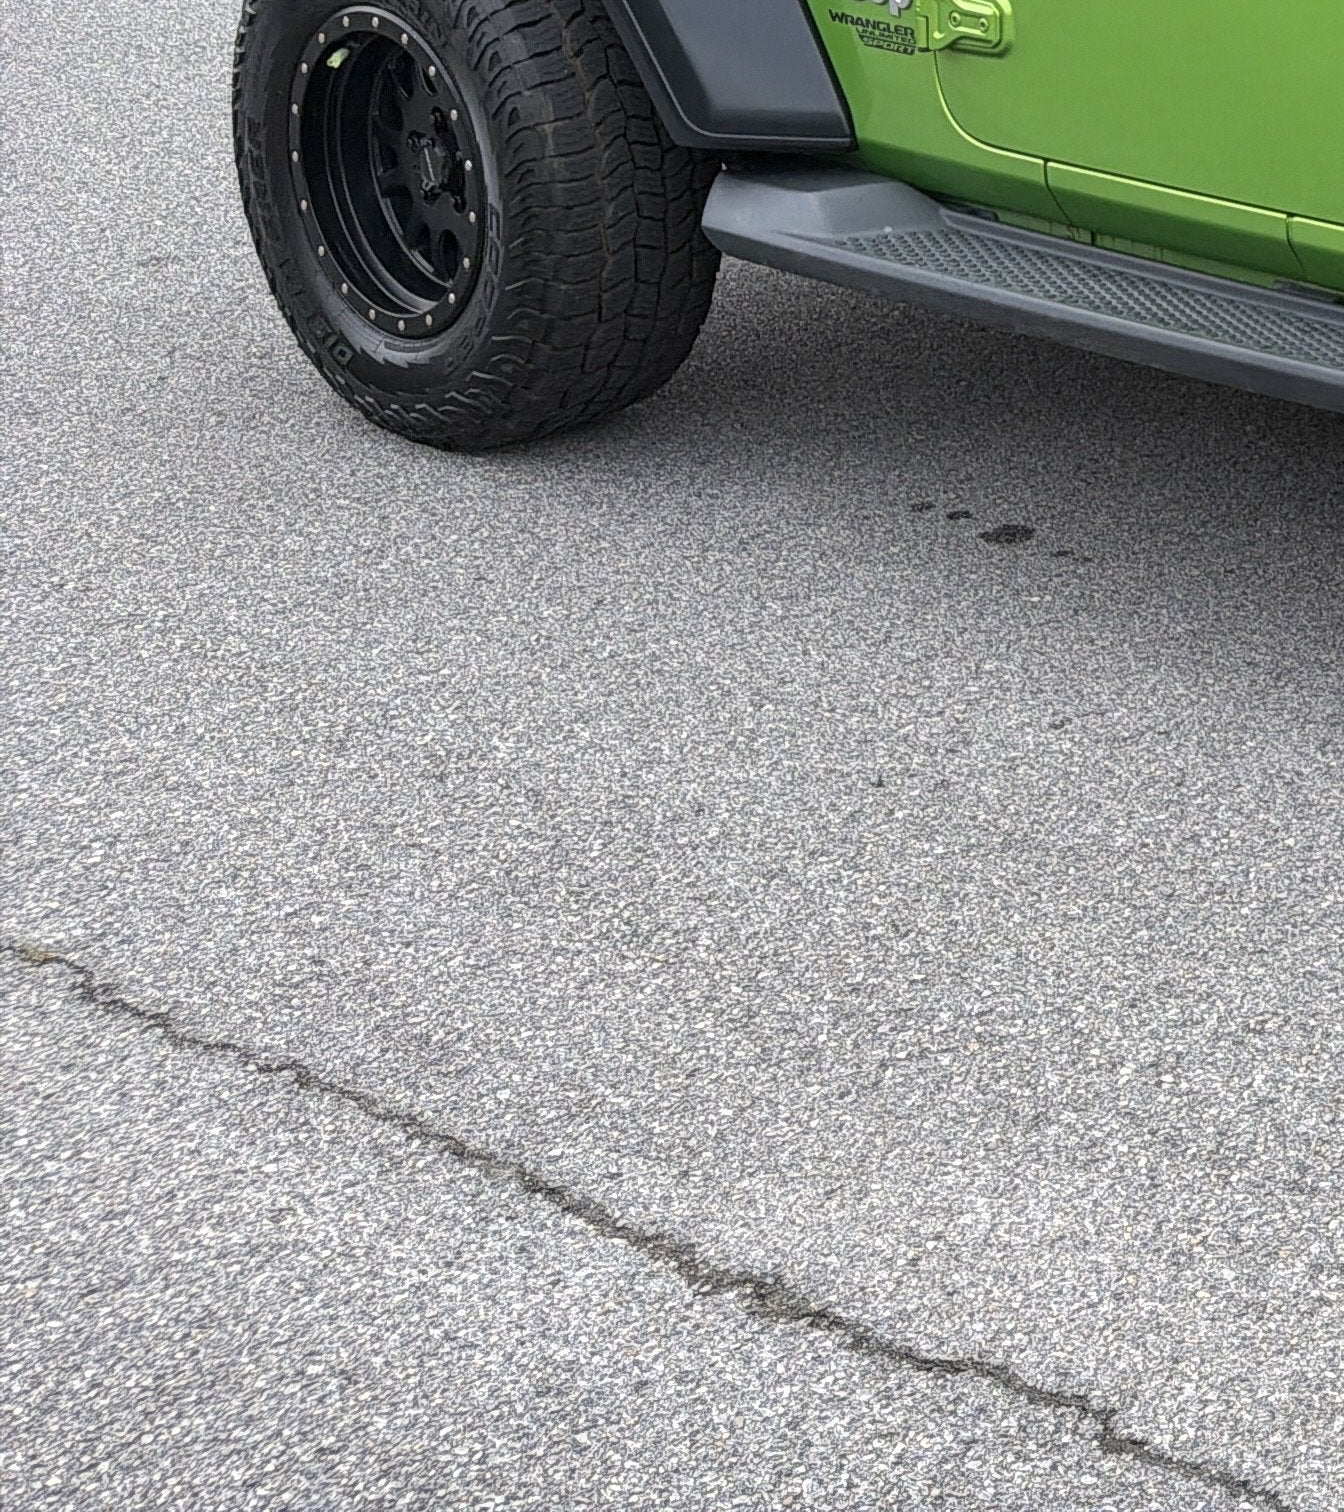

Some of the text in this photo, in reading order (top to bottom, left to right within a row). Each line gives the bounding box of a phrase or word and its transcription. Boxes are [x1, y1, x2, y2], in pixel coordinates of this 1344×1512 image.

[828, 9, 916, 39] WRANGLER
[860, 29, 916, 45] UNLIMITED
[862, 36, 916, 55] SPORT
